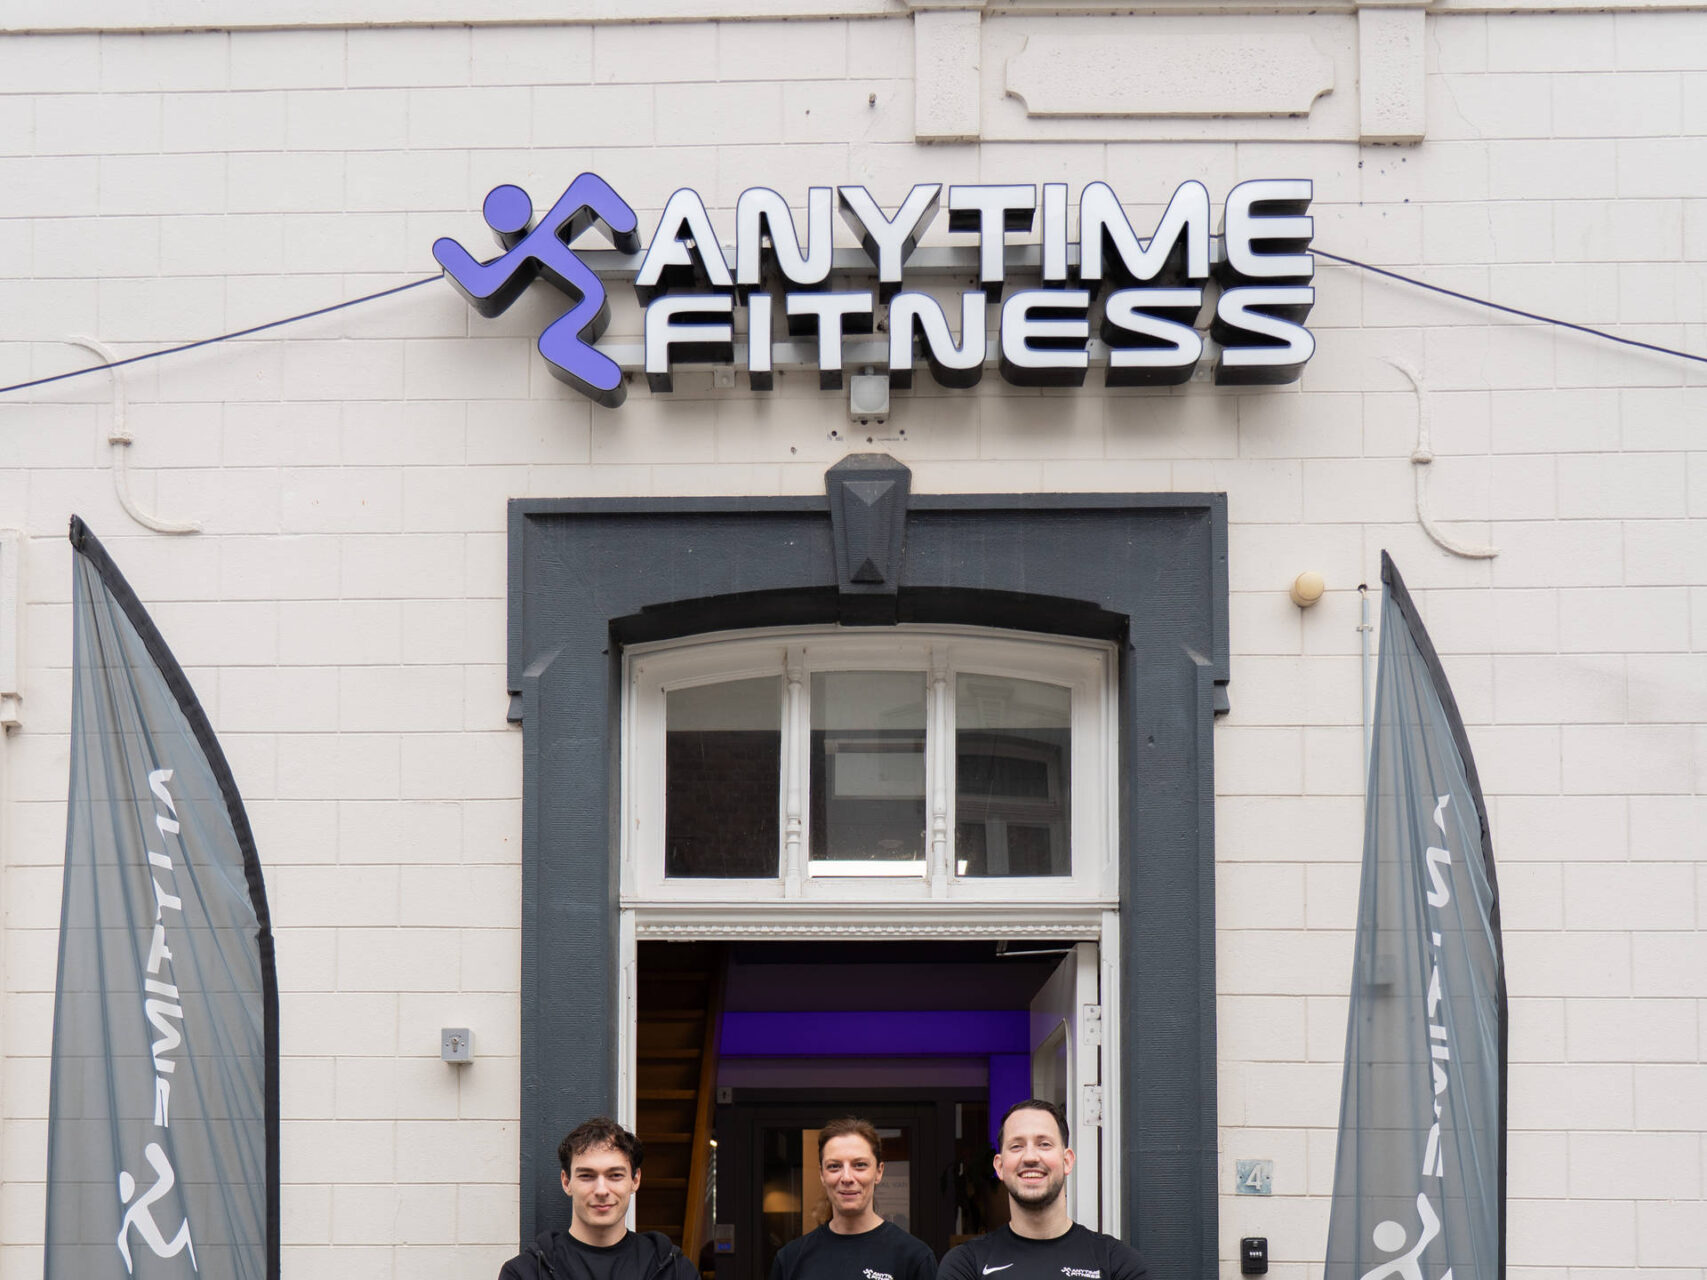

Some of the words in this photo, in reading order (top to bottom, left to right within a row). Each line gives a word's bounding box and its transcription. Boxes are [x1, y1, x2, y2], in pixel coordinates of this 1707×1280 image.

[634, 177, 1316, 292] ANYTIME
[643, 285, 1317, 378] FITNESS
[1245, 1163, 1264, 1191] 4
